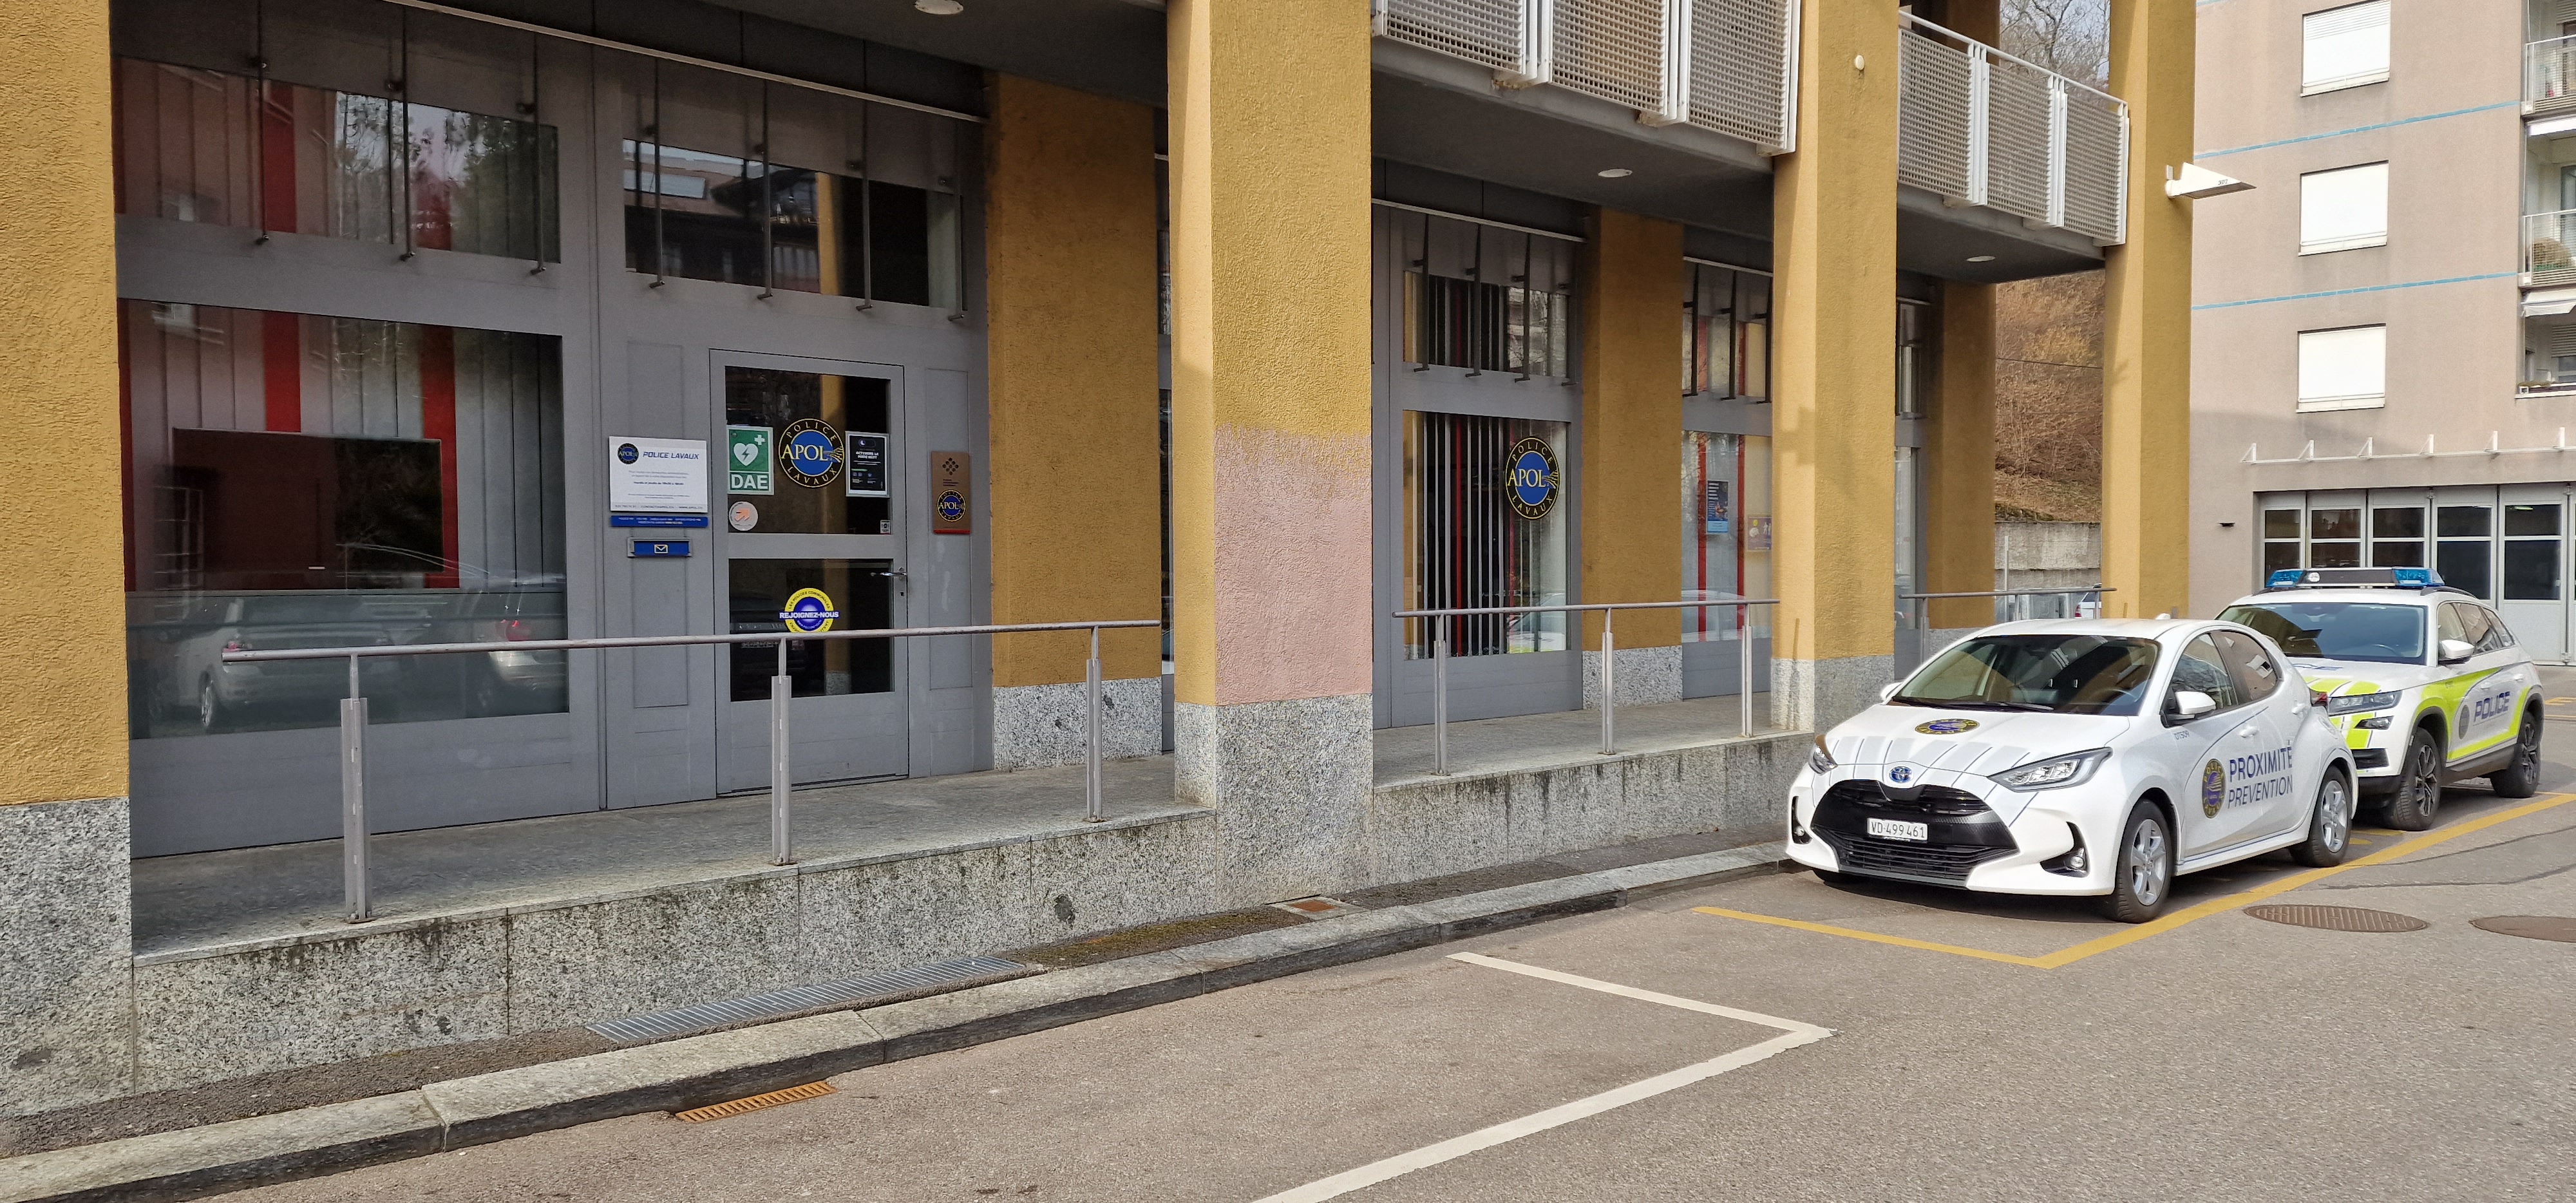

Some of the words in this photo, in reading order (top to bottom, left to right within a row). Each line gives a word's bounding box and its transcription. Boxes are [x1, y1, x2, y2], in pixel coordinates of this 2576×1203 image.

[786, 421, 837, 442] POLICE
[781, 444, 829, 461] APOL
[1511, 441, 1553, 464] POLICE
[731, 474, 768, 489] DAE
[787, 466, 837, 485] LAVAUX
[1507, 468, 1546, 488] APOL
[938, 502, 959, 510] APOL
[1511, 495, 1553, 516] LAVAUX
[2473, 691, 2510, 723] POLICE
[2228, 774, 2293, 810] PREVENTION
